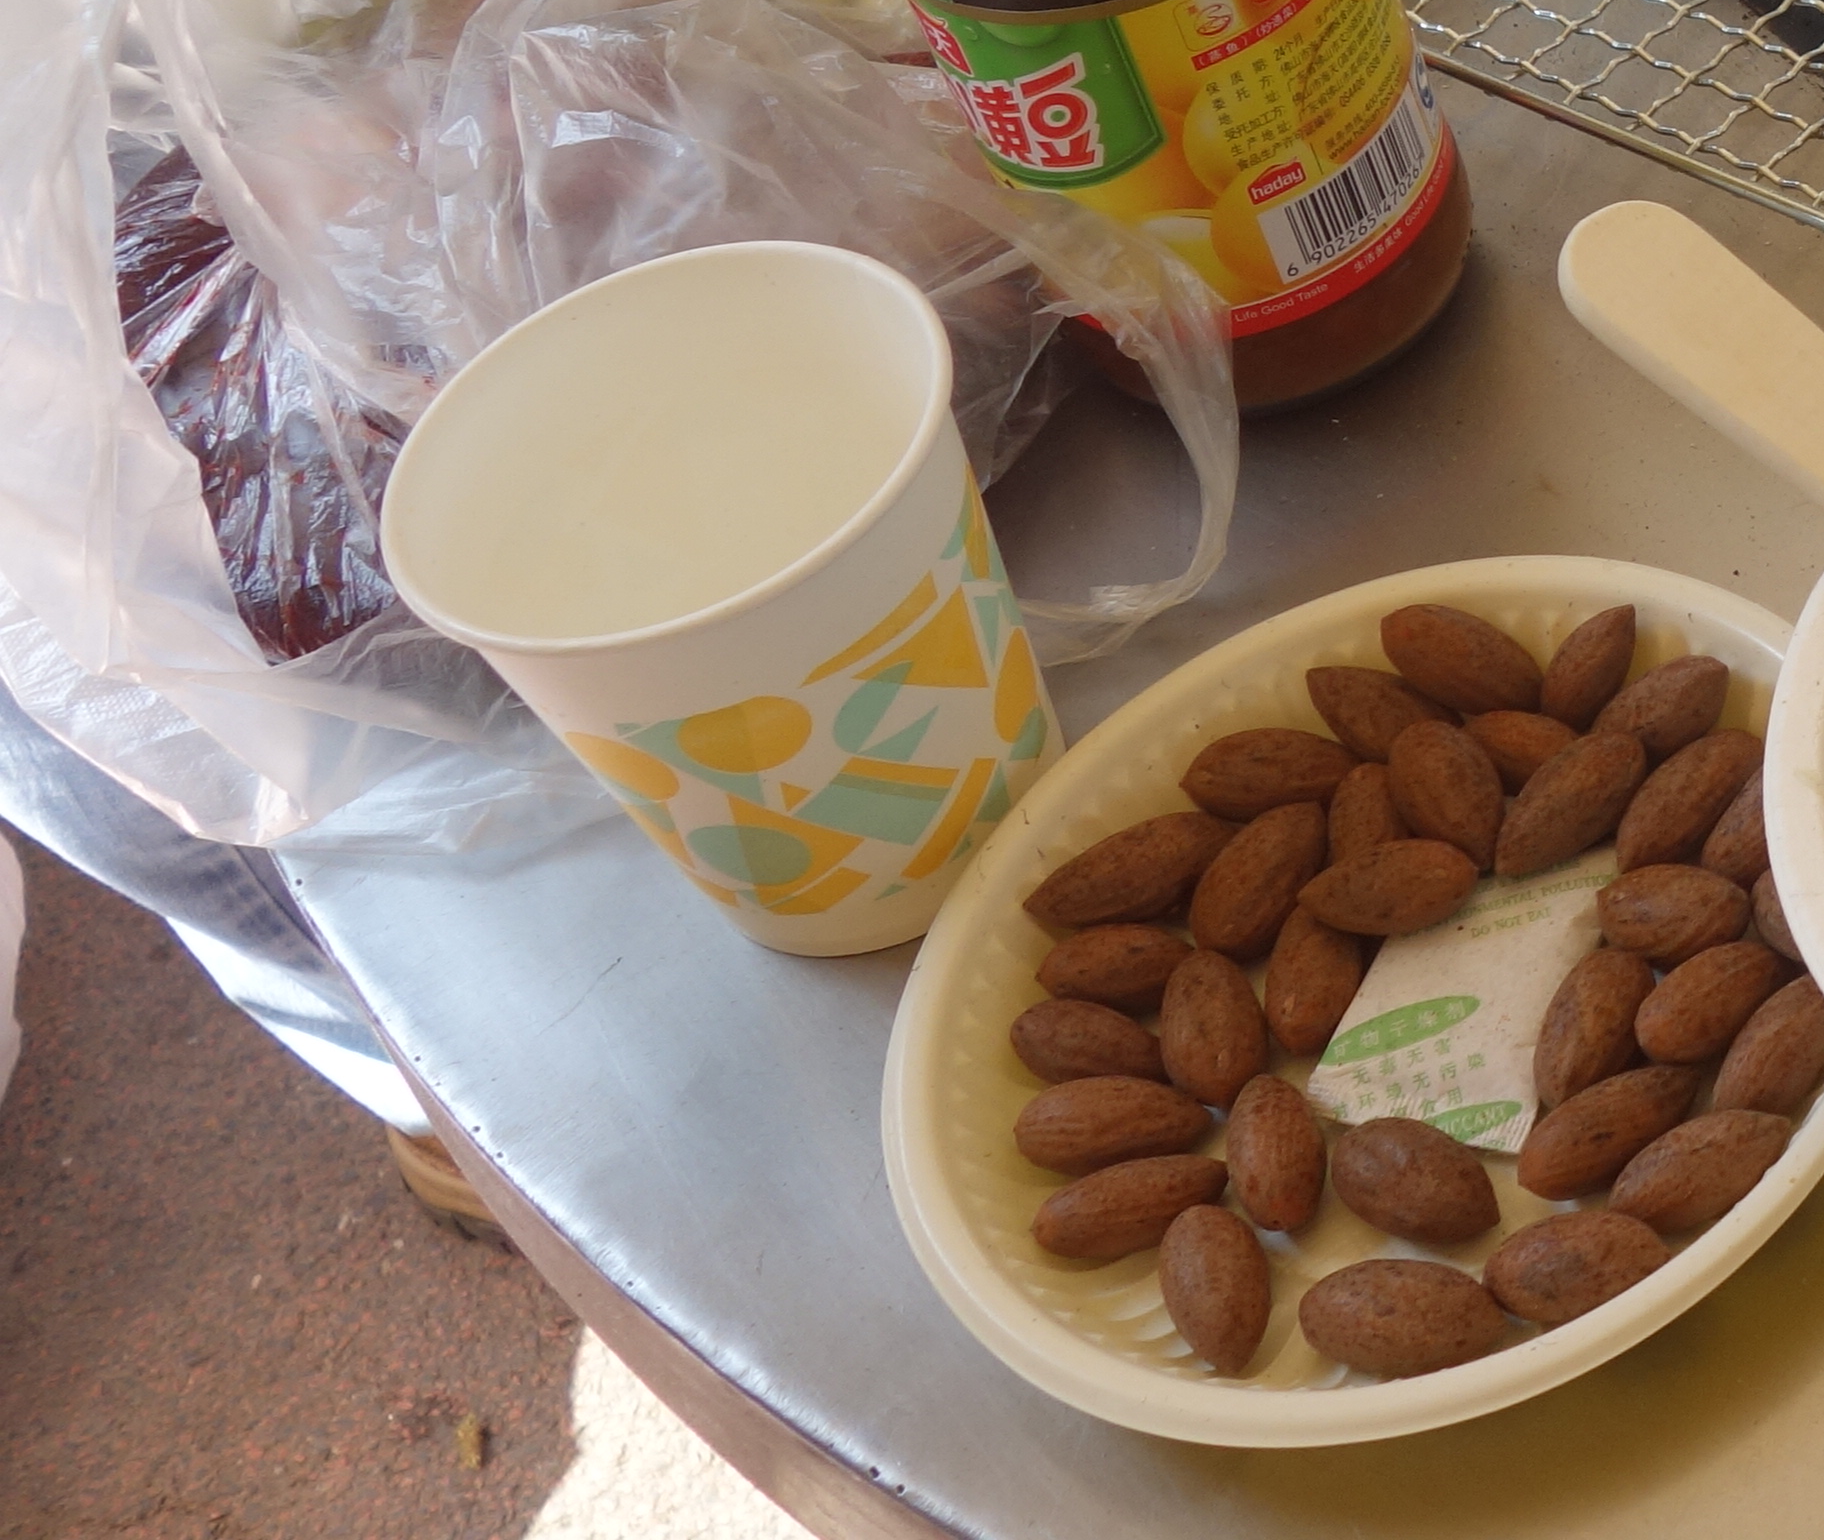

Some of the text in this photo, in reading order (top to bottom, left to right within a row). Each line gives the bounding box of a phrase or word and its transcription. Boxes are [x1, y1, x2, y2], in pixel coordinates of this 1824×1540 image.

[1250, 166, 1304, 201] haday
[1286, 263, 1299, 277] 6
[1234, 281, 1329, 324] Life Good Taste
[1470, 920, 1491, 939] DO
[1494, 913, 1524, 932] NOT
